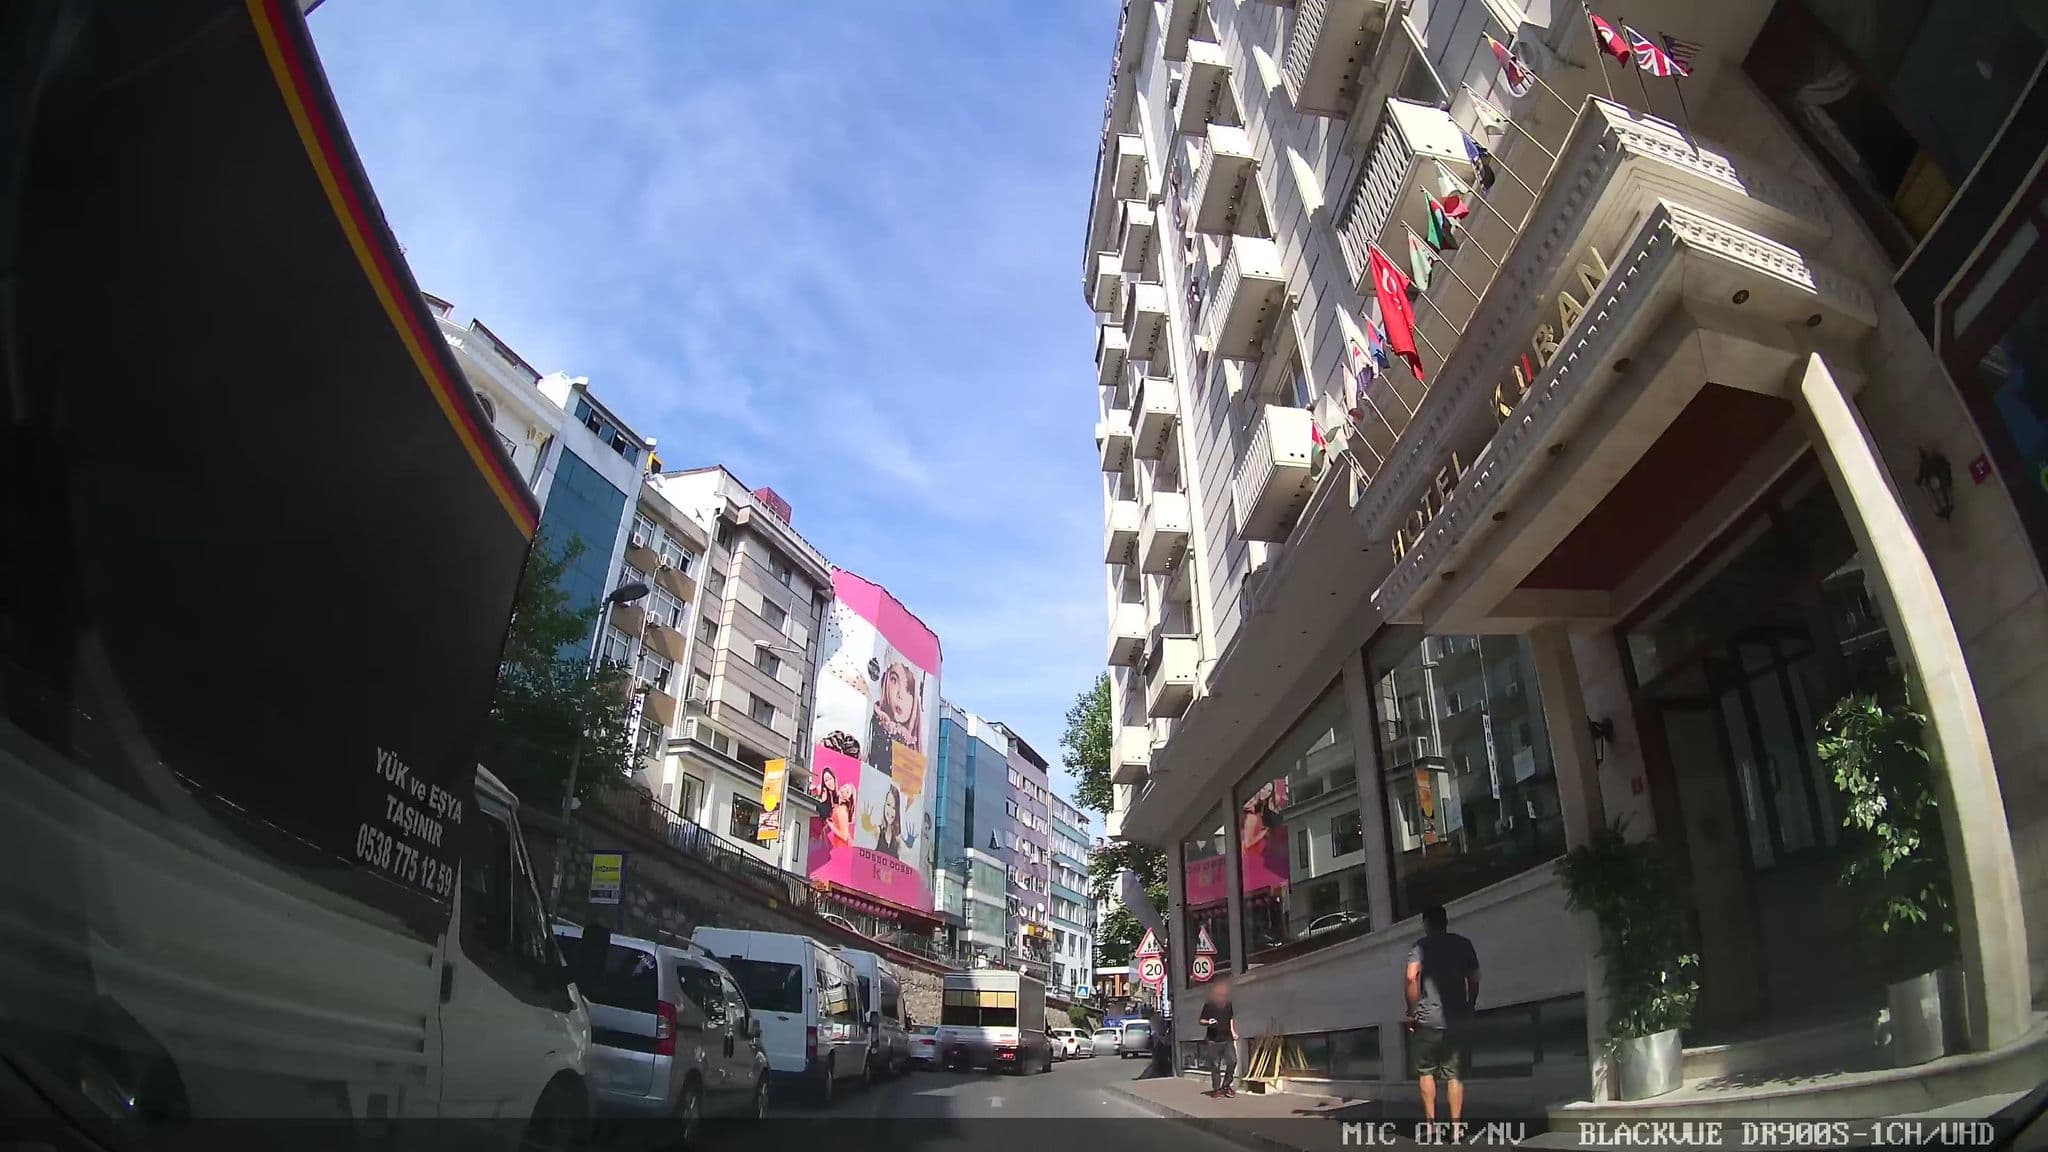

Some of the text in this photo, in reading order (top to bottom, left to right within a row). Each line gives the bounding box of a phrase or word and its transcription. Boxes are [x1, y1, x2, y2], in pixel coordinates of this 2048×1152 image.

[375, 746, 463, 825] YÜK ve EŞYA
[386, 794, 444, 848] TAŞINIR
[356, 823, 453, 897] 0538 775 12 59
[1145, 963, 1162, 976] 20
